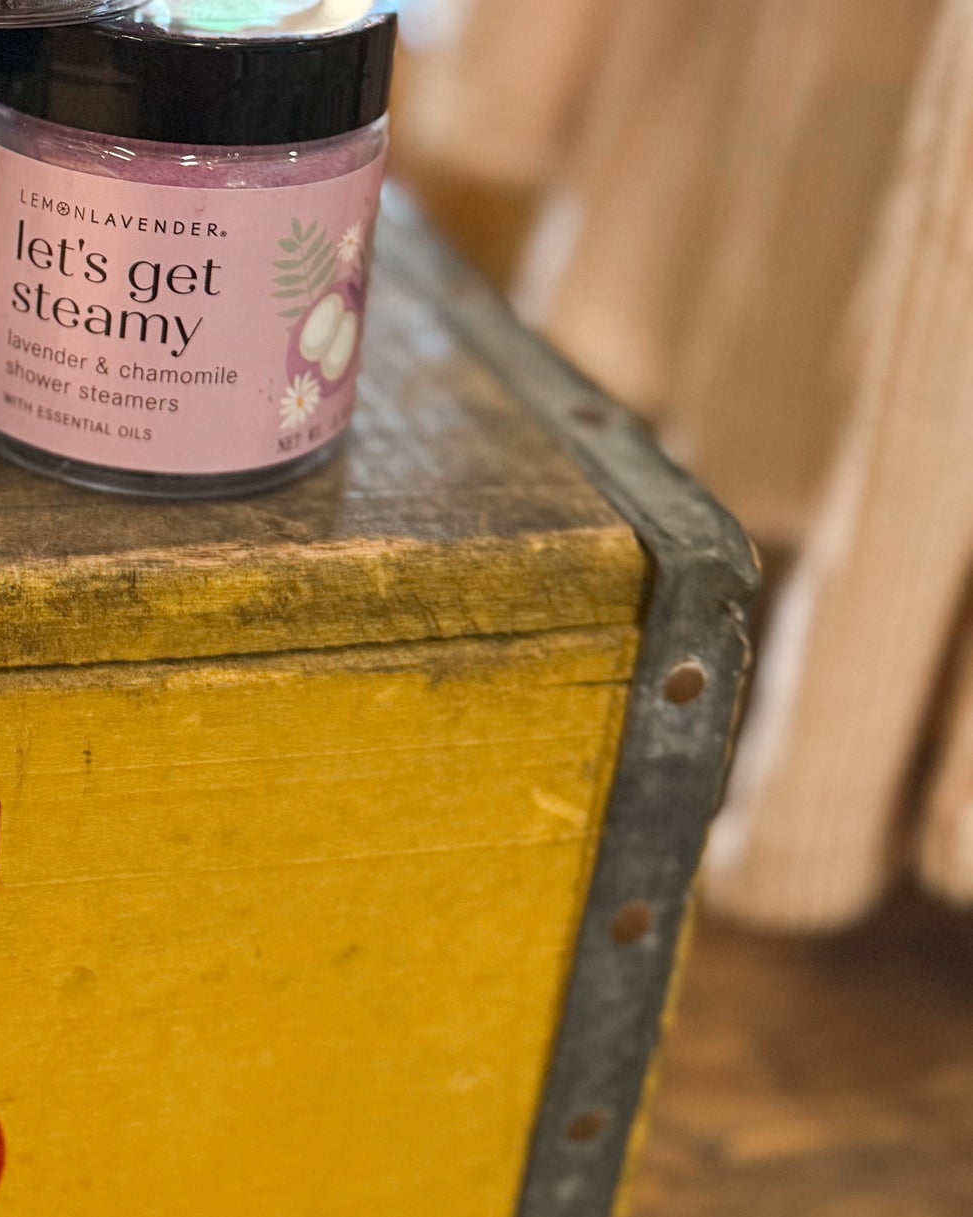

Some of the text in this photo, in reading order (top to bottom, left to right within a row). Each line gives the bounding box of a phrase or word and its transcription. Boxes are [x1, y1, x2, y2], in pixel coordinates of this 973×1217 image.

[15, 220, 108, 284] let's
[127, 256, 221, 304] get
[11, 281, 204, 358] steamy
[7, 329, 238, 385] lavender & chamomile
[5, 358, 70, 395] shower
[78, 382, 179, 413] steamers
[3, 391, 152, 441] WITH ESSENTIAL OILS
